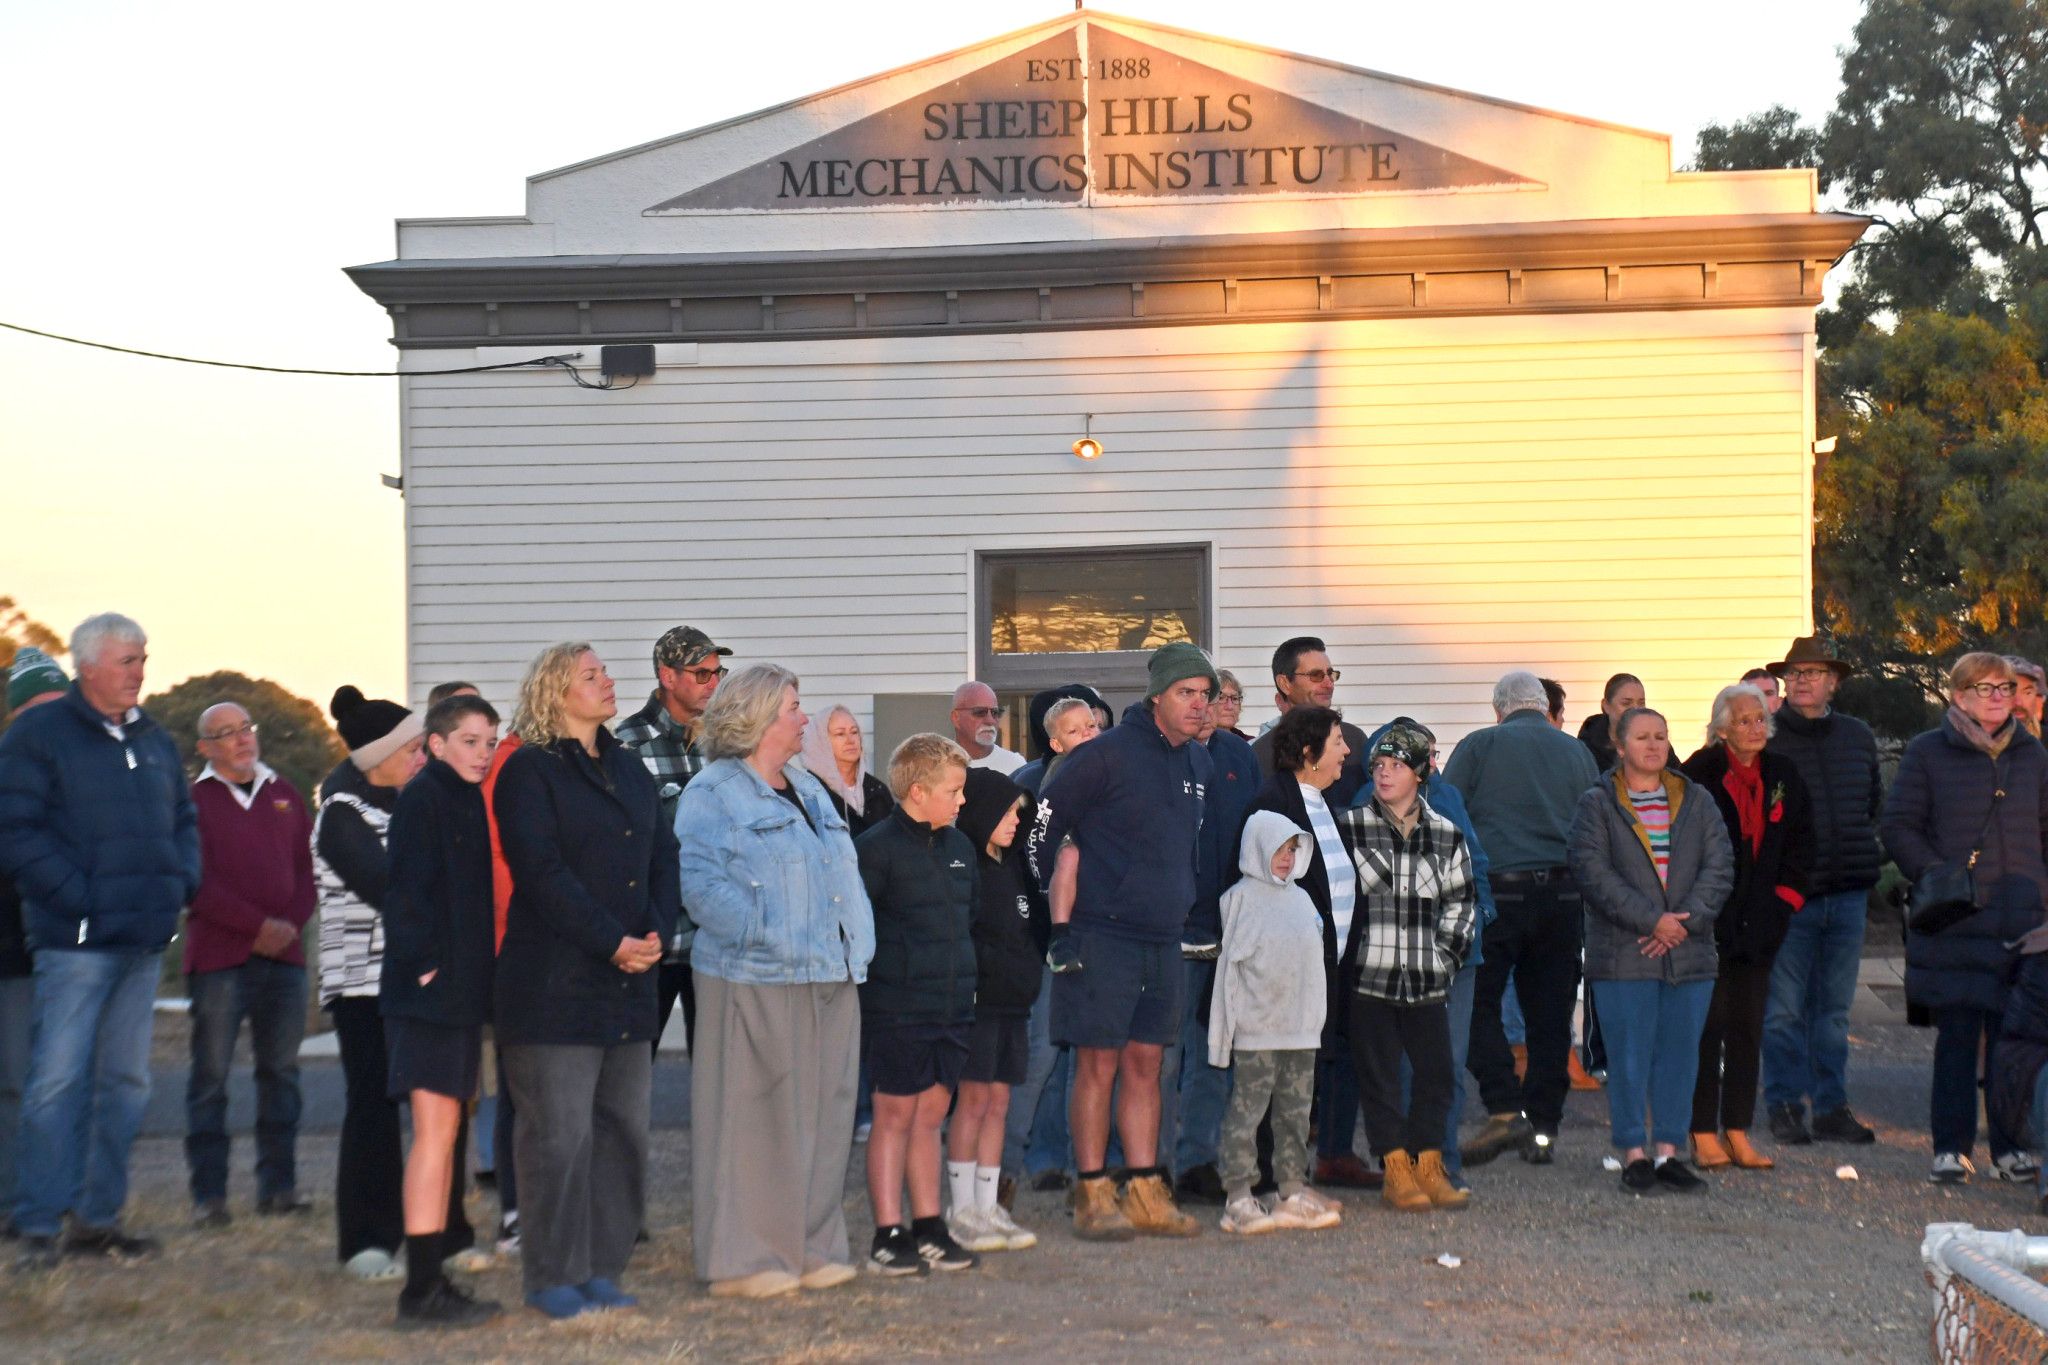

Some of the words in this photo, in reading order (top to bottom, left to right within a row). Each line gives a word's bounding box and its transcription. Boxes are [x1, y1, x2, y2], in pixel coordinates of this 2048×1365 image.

[1100, 57, 1151, 80] 1888
[923, 99, 1088, 141] SHEEP
[1100, 94, 1252, 137] HILLS
[776, 154, 1089, 199] MECHANICS
[1103, 142, 1401, 191] INSTITUTE
[1038, 813, 1051, 843] PLUS
